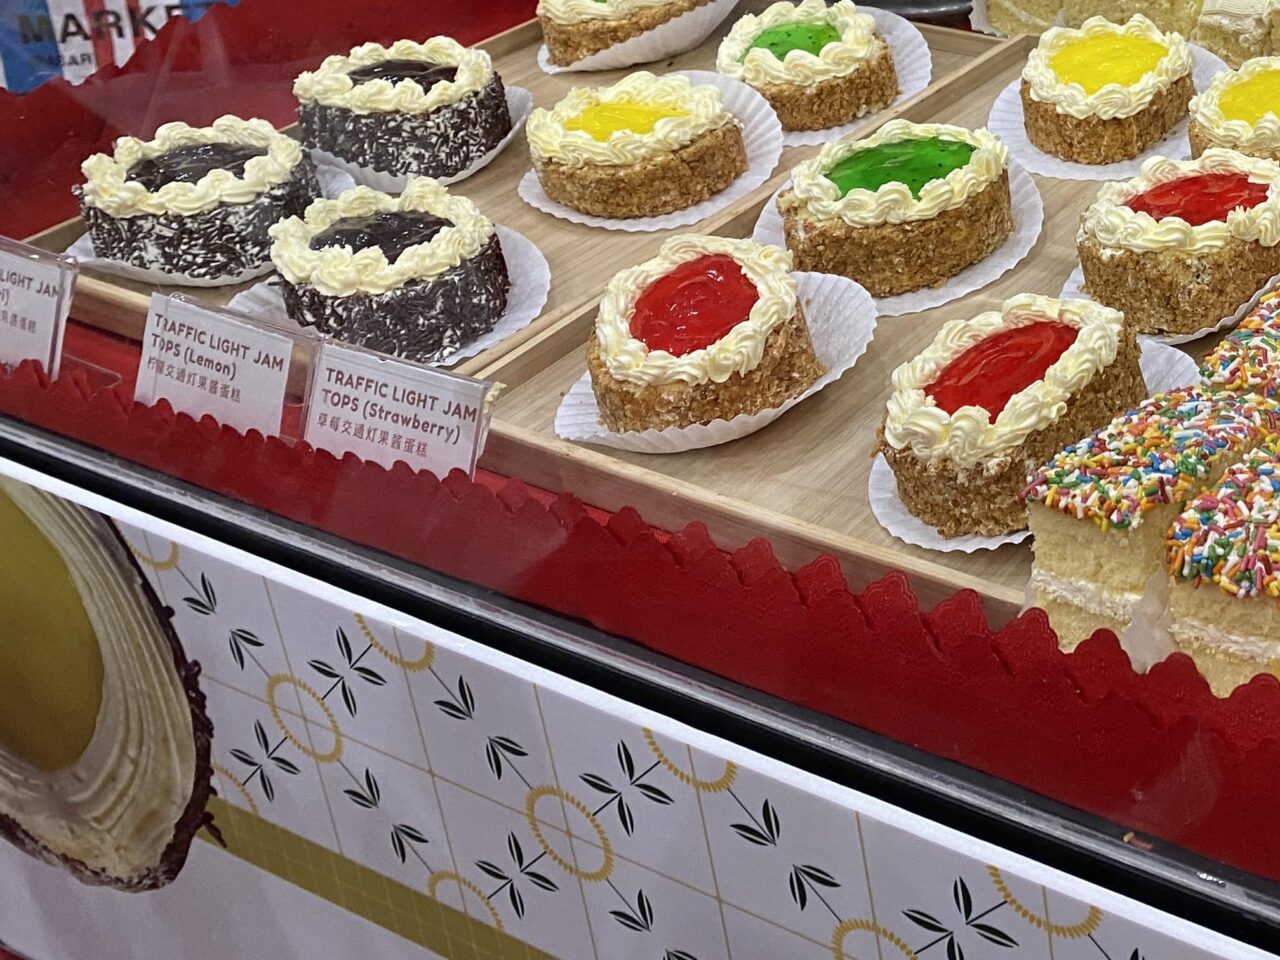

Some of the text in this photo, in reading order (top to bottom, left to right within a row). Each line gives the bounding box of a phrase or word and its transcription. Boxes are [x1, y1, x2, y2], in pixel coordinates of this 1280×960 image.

[0, 269, 33, 290] LIGHT
[151, 333, 237, 381] TOPS (Lemon)
[154, 313, 284, 372] TRAFFIC LIGHT JAM
[322, 388, 461, 445] TOPS (Strawberry)
[326, 367, 478, 423] TRAFFIC LIGHT JAM
